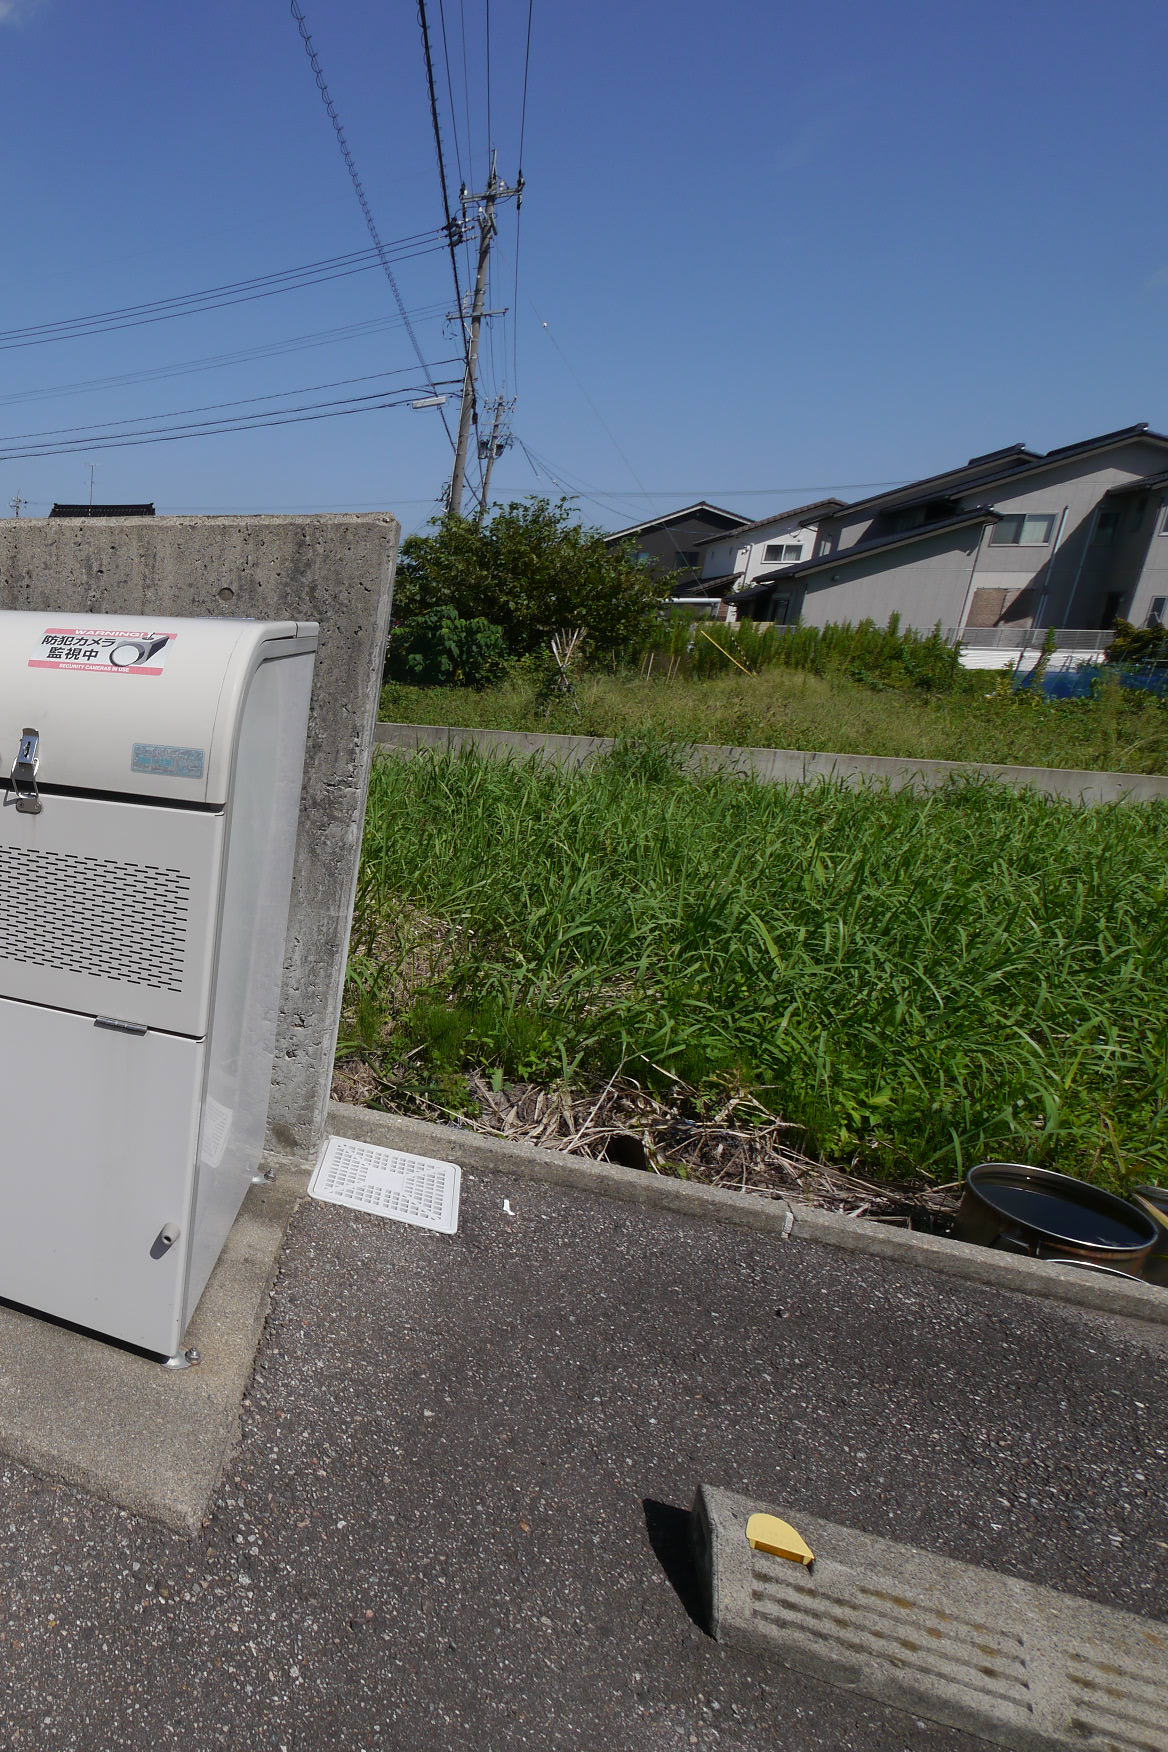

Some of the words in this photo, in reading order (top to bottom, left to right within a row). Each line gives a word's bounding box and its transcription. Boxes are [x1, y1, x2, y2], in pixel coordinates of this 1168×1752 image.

[41, 635, 116, 648] 防犯カメラ
[46, 647, 99, 661] 監視中
